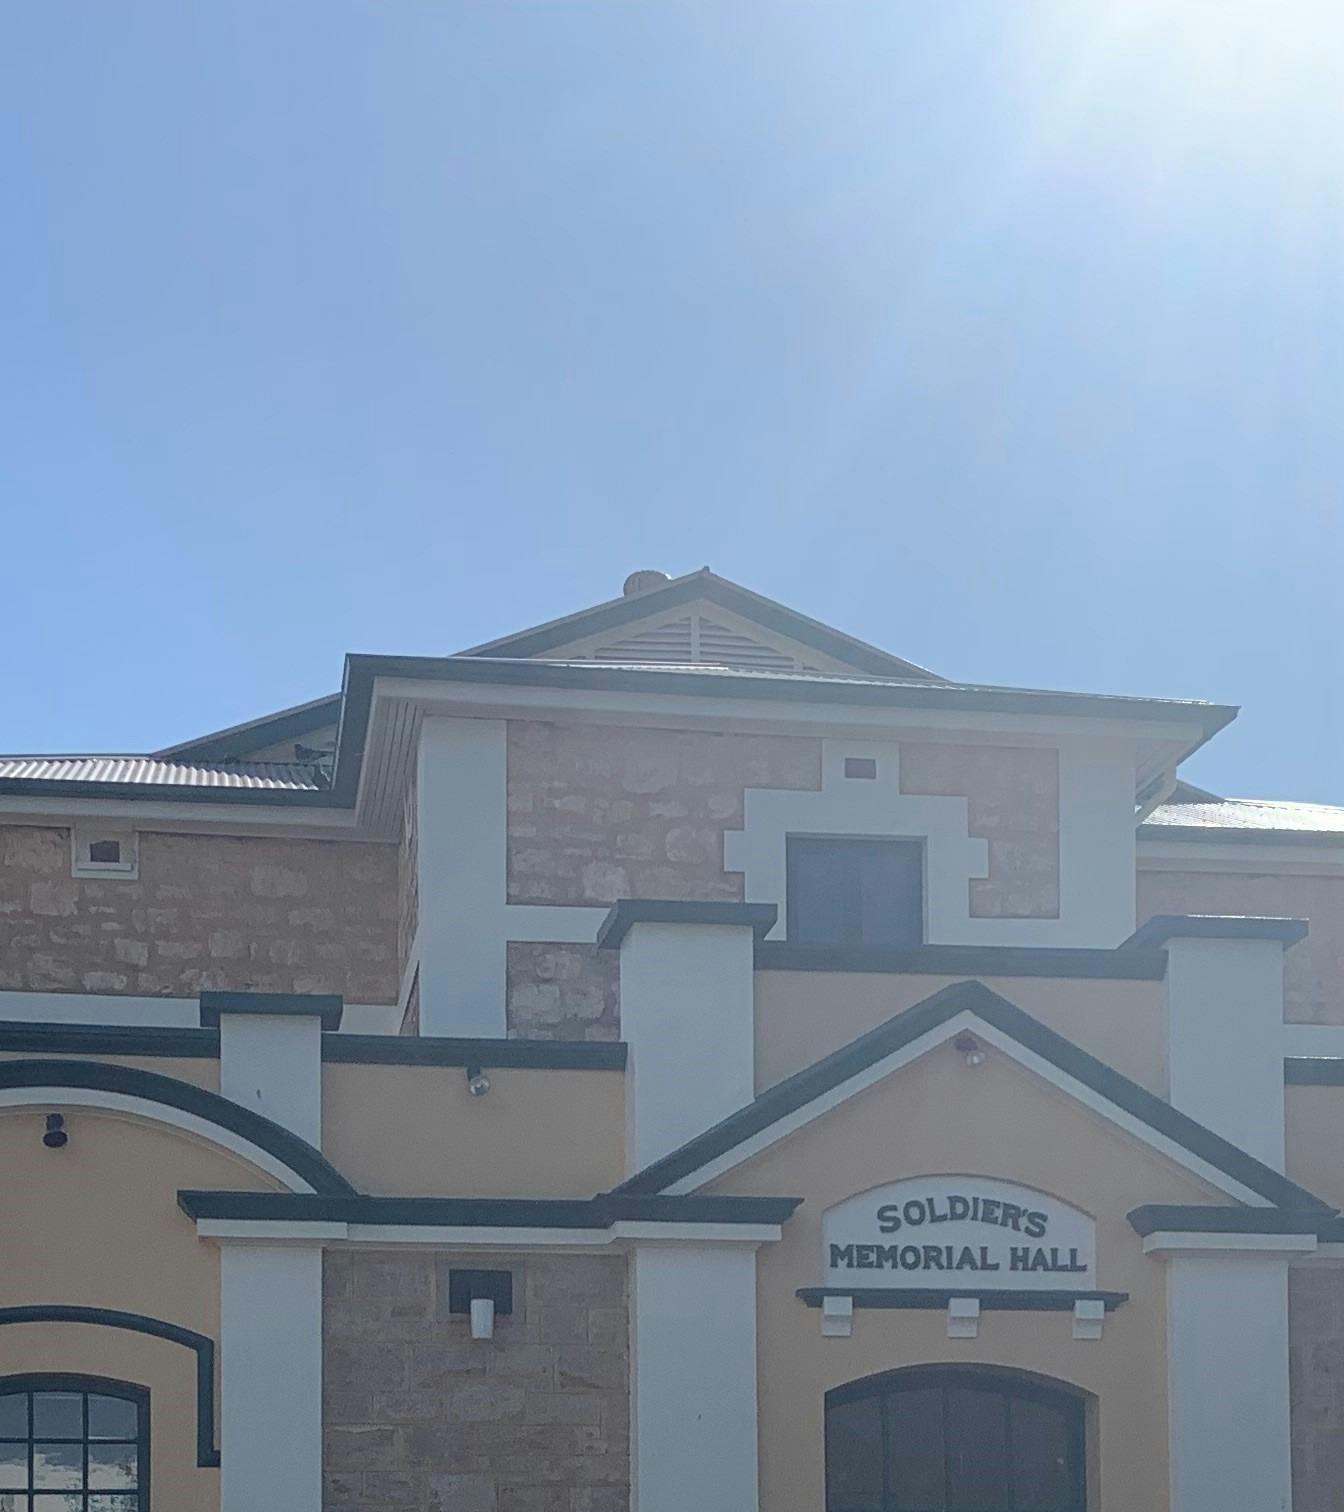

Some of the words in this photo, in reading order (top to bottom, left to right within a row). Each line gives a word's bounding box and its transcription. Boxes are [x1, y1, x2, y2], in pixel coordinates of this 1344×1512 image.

[876, 1195, 1049, 1239] SOLDIER'S
[829, 1243, 1000, 1271] MEMORIAL
[1009, 1246, 1088, 1272] HALL
